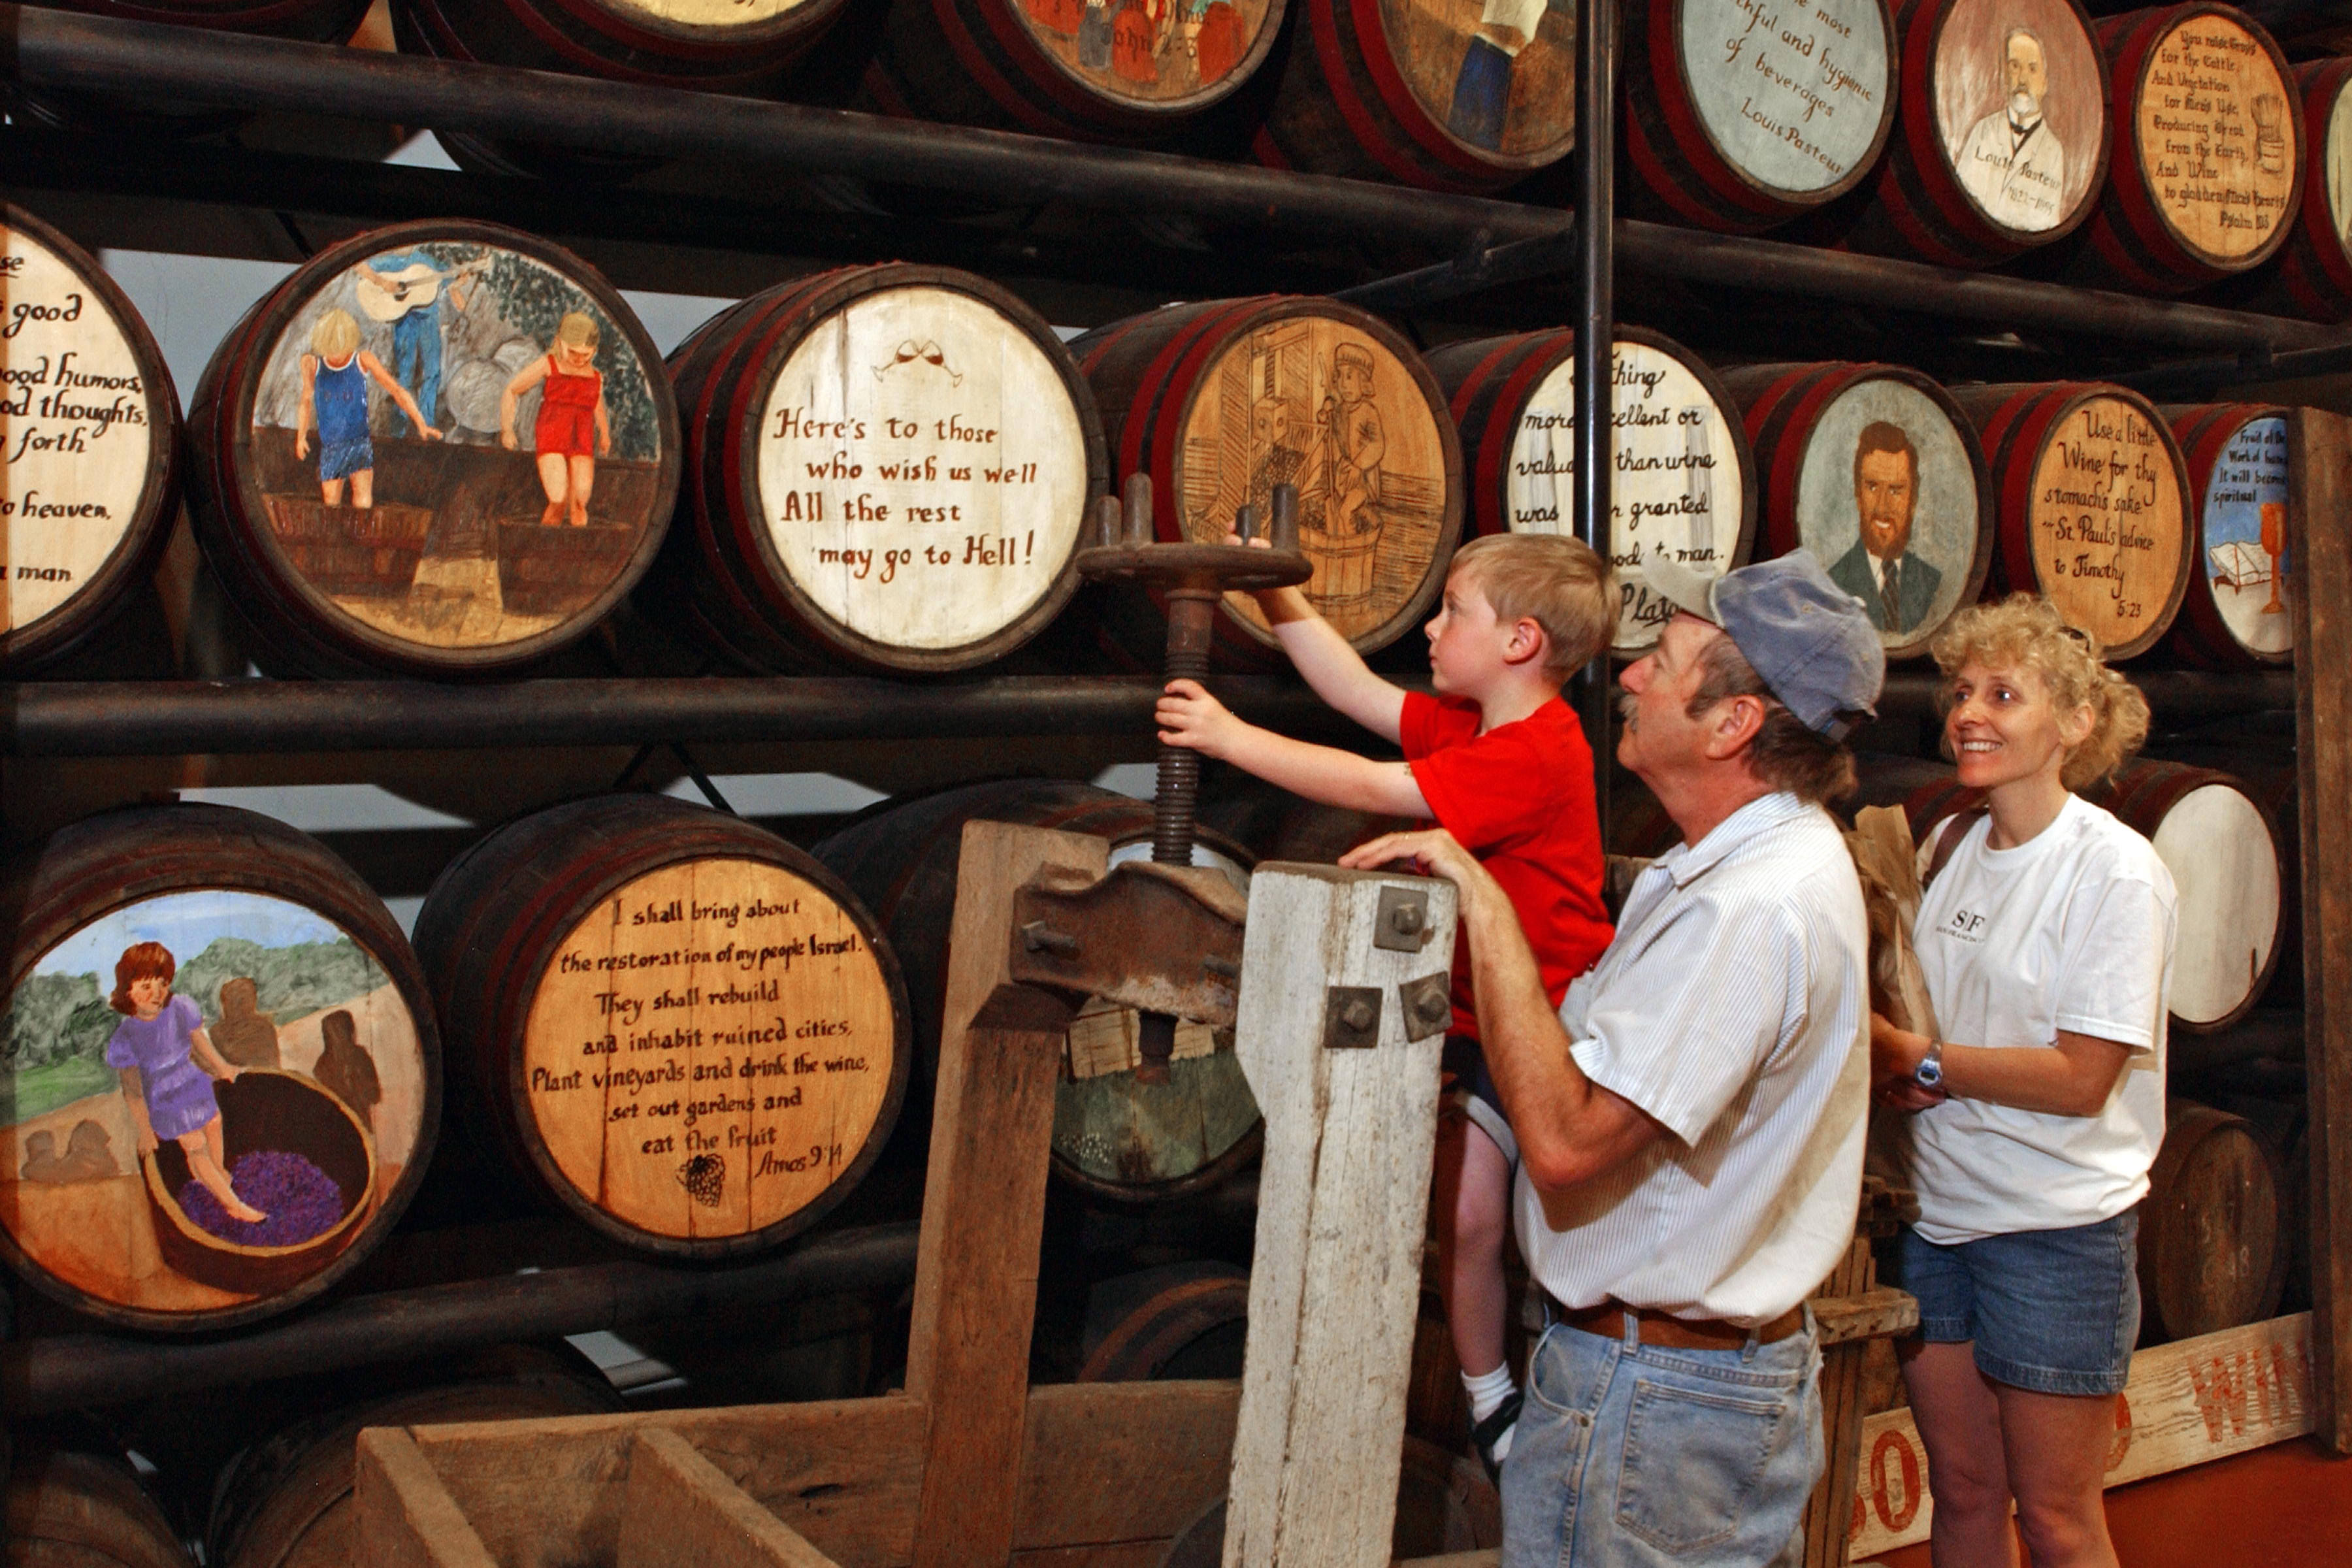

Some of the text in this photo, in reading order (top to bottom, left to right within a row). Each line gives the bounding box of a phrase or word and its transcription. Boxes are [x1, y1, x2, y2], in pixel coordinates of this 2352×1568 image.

[1816, 9, 1852, 38] most
[1782, 30, 1814, 57] and
[1819, 47, 1872, 101] hygienic
[2151, 69, 2174, 86] And
[2183, 52, 2199, 73] the
[1725, 37, 1835, 122] of beverages
[1741, 97, 1844, 175] Louis Pasteur
[2153, 114, 2209, 143] Producing
[1974, 145, 2061, 189] Louis Pasteur
[2166, 139, 2191, 155] from
[2195, 142, 2211, 165] the
[2156, 160, 2219, 179] And Wine
[2165, 184, 2177, 199] to
[2219, 210, 2253, 229] Psalm
[3, 293, 82, 338] good
[0, 352, 142, 394] ood humors,
[1611, 359, 1666, 398] hing
[41, 389, 148, 438] thoughts,
[773, 406, 1000, 444] Here's to those
[1611, 404, 1671, 427] cellent
[1678, 410, 1705, 426] or
[2082, 410, 2157, 448] Use a little
[7, 426, 87, 465] forth
[1516, 446, 1717, 476] valua than wine
[806, 451, 1037, 484] who wish us well
[2057, 441, 2156, 507] Wine for thy
[2219, 467, 2228, 483] It
[2231, 469, 2250, 483] will
[22, 489, 112, 520] heaven,
[781, 490, 962, 523] All the rest
[1516, 507, 1560, 523] was
[1630, 493, 1709, 531] granted
[2044, 482, 2109, 512] stomach's
[2213, 488, 2257, 509] spiritual
[2055, 515, 2155, 551] St. Paul's advice
[818, 547, 873, 580] may
[880, 547, 911, 583] go
[924, 546, 952, 564] to
[1610, 541, 1642, 566] od
[1676, 547, 1724, 563] man.
[18, 566, 73, 582] man
[2054, 553, 2125, 600] to Timothy
[1620, 583, 1681, 621] Plato
[2116, 600, 2142, 619] 5:23
[611, 898, 802, 928] I shall bring about
[1951, 909, 1985, 932] SF
[561, 934, 863, 973] the restoration of my people Israel.
[595, 979, 779, 1026] They shall rebuild
[583, 1017, 853, 1056] and inhabit ruined cities,
[531, 1052, 871, 1096] Plant vineyards and drink the wine,
[608, 1086, 803, 1128] set out gardens and
[642, 1125, 778, 1155] eat the fruit
[755, 1150, 807, 1178] Amos
